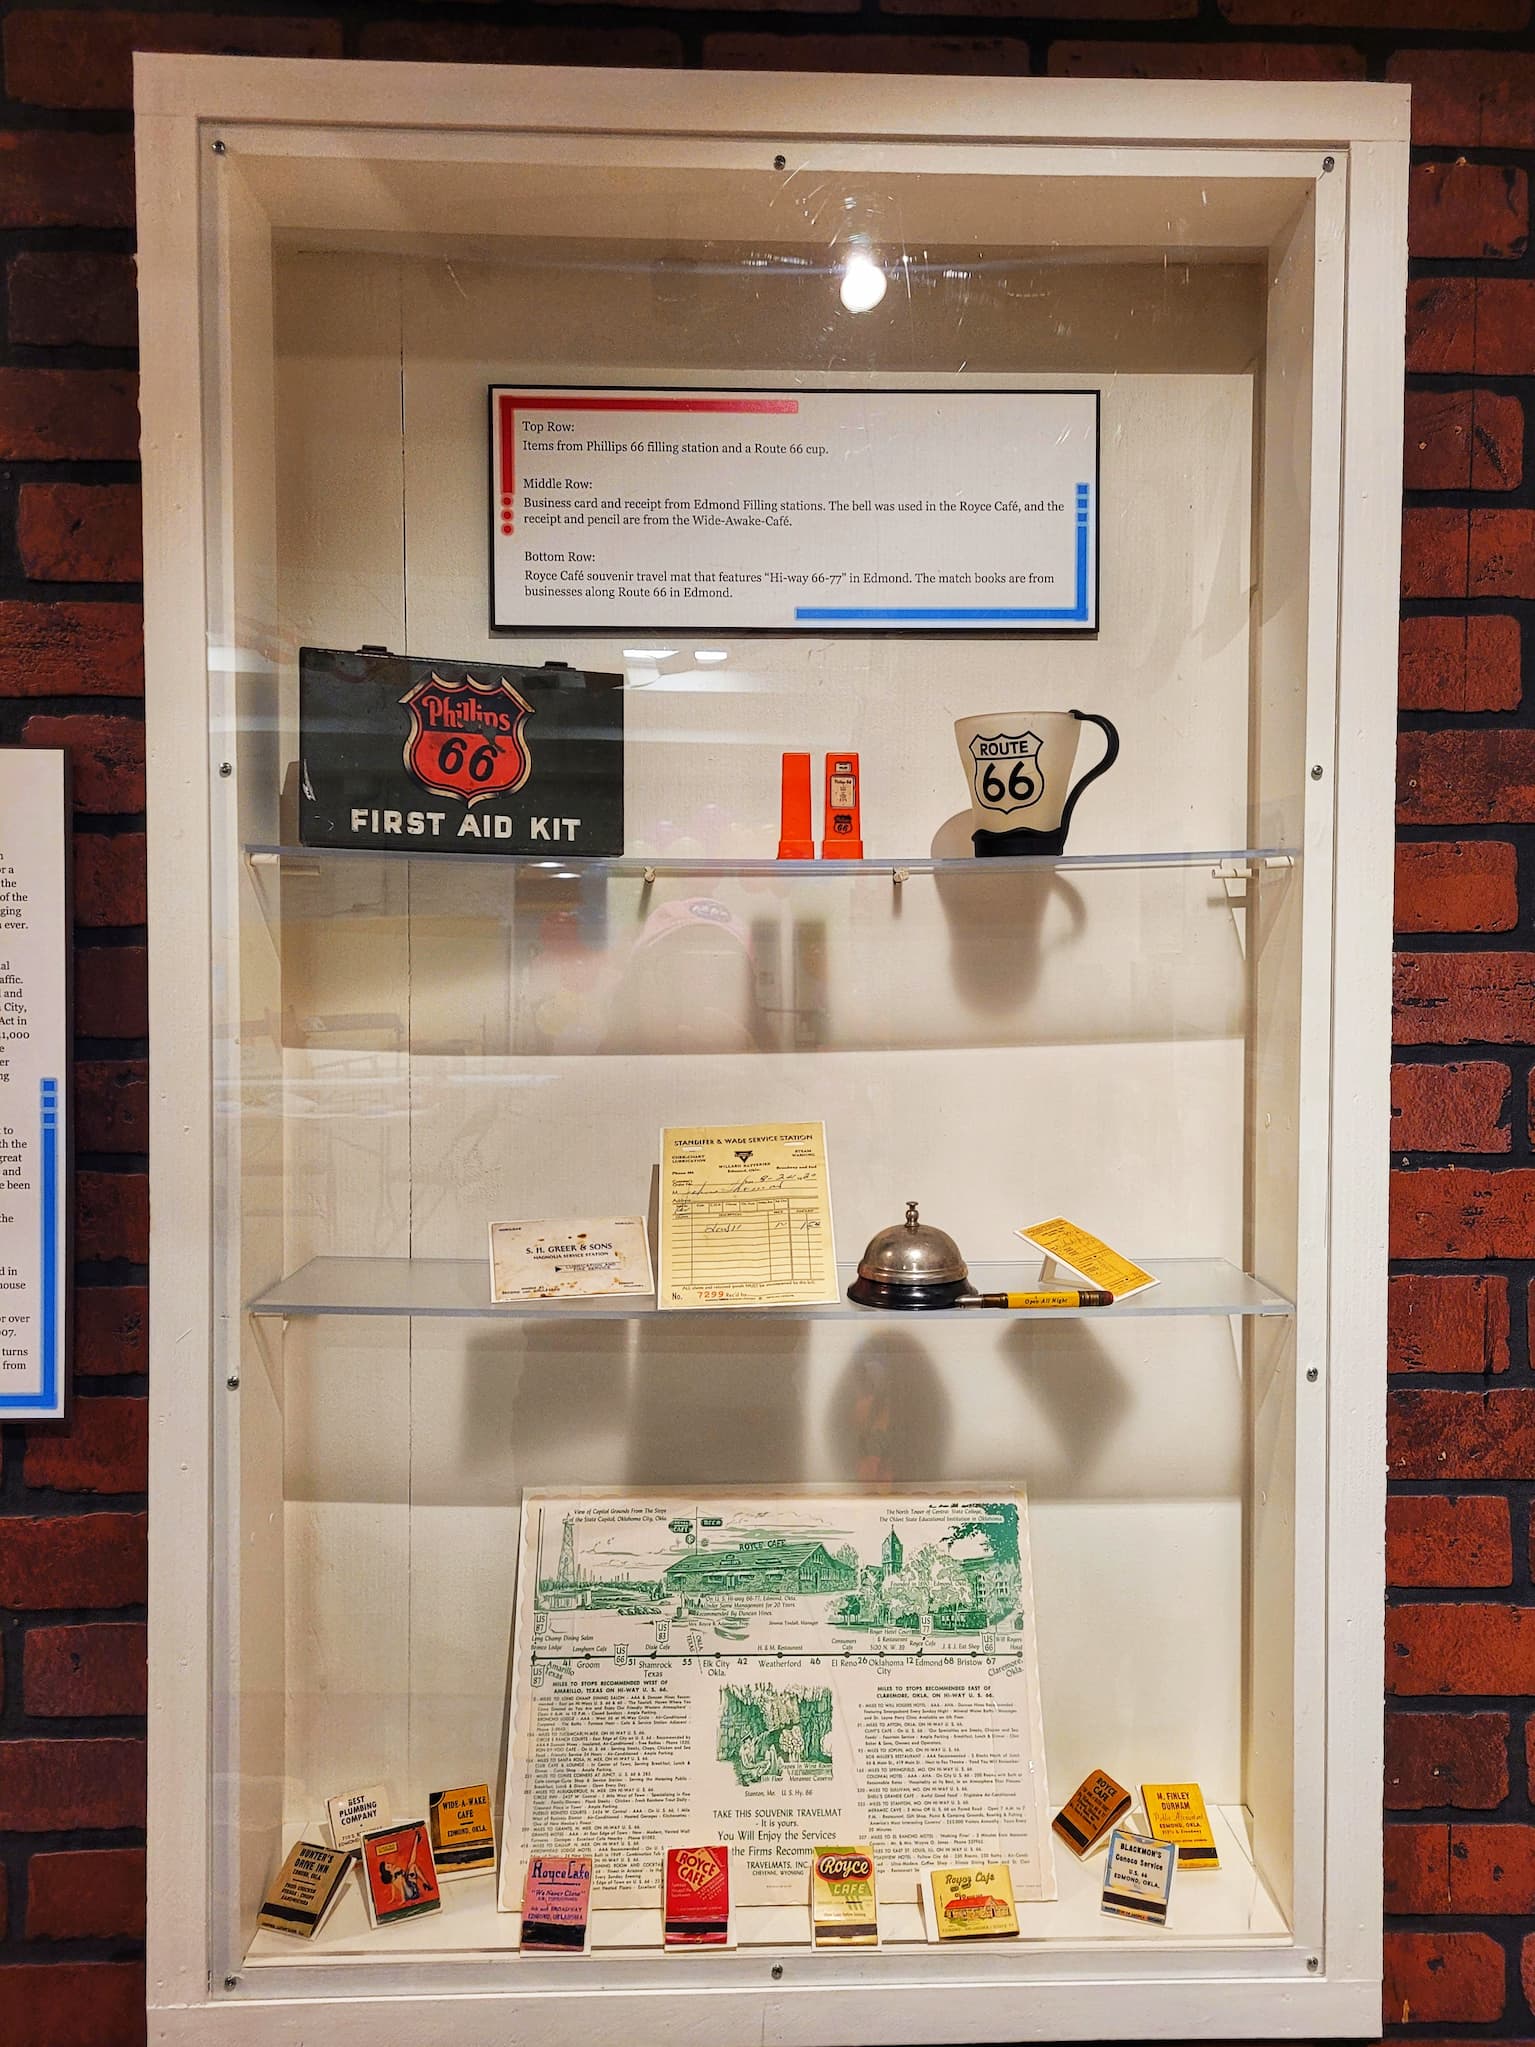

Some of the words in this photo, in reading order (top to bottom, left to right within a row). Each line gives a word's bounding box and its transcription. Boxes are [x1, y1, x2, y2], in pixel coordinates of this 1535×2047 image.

[523, 422, 543, 434] Top
[548, 422, 574, 432] Row:
[523, 441, 554, 450] Items
[557, 440, 583, 451] from
[587, 441, 627, 454] Phillips
[631, 442, 644, 452] 66
[648, 441, 680, 455] filling
[682, 442, 720, 453] station
[722, 443, 743, 453] and
[755, 443, 786, 453] Route
[790, 444, 803, 453] 66
[806, 447, 828, 456] cup.
[524, 478, 561, 488] Middle
[565, 479, 592, 489] Row:
[524, 497, 571, 508] Business
[574, 498, 598, 508] card
[601, 498, 621, 508] and
[625, 498, 661, 511] receipt
[665, 498, 690, 509] from
[694, 499, 740, 510] Edmond
[743, 499, 777, 513] Filling
[780, 500, 825, 511] stations.
[828, 500, 849, 511] The
[852, 500, 871, 511] bell
[898, 501, 923, 511] used
[926, 501, 936, 511] in
[939, 501, 956, 511] the
[960, 501, 991, 513] Royce
[995, 500, 1021, 512] Café,
[1024, 501, 1044, 511] and
[1047, 500, 1064, 511] the
[524, 513, 561, 526] receipt
[564, 513, 584, 524] and
[587, 514, 620, 527] pencil
[623, 517, 640, 525] are
[643, 514, 669, 525] from
[673, 514, 689, 525] the
[692, 515, 792, 526] Wide-Awake-Café.
[525, 551, 564, 562] Bottom
[568, 552, 595, 562] Row:
[525, 570, 557, 582] Royce
[560, 570, 584, 581] Café
[587, 571, 634, 581] souvenir
[637, 571, 666, 581] travel
[671, 573, 691, 582] mat
[694, 571, 715, 582] that
[719, 572, 761, 582] features
[850, 573, 860, 583] in
[864, 573, 912, 583] Edmond.
[915, 572, 935, 583] The
[939, 572, 971, 583] match
[974, 572, 1006, 583] books
[1029, 573, 1054, 583] from
[525, 586, 582, 596] businesses
[585, 586, 615, 599] along
[619, 587, 650, 597] Route
[653, 587, 666, 597] 66
[670, 587, 680, 597] in
[684, 587, 732, 597] Edmond.
[421, 695, 511, 731] Phillips
[979, 740, 1029, 756] ROUTE
[439, 737, 498, 782] 66
[982, 761, 1035, 803] 66
[350, 808, 446, 836] FIRST
[457, 814, 513, 840] AID
[530, 817, 582, 842] KIT
[12, 892, 28, 901] the
[4, 988, 22, 998] and
[4, 1002, 27, 1013] City,
[11, 1139, 27, 1149] the
[748, 1135, 778, 1144] SERVICE
[780, 1133, 814, 1143] STATION
[2, 1166, 21, 1176] and
[7, 1180, 31, 1190] been
[548, 1244, 577, 1253] GREER
[580, 1244, 587, 1252] &
[589, 1242, 614, 1251] SONS
[697, 1290, 725, 1298] 7299
[1024, 1297, 1040, 1306] Open
[1052, 1296, 1068, 1304] Night
[2, 1348, 29, 1357] turns
[2, 1360, 26, 1370] from
[740, 1541, 762, 1551] ROYCE
[768, 1540, 785, 1548] CAFE
[577, 1661, 600, 1669] Groom
[639, 1661, 672, 1669] Shamrock
[703, 1660, 713, 1668] Elk
[714, 1660, 729, 1669] City
[758, 1659, 801, 1668] Weatherford
[869, 1659, 904, 1667] Oklahoma
[915, 1659, 943, 1667] Edmond
[877, 1667, 891, 1676] City
[442, 1797, 487, 1810] WIDE-A-WAKE
[1161, 1801, 1191, 1810] DURHAM
[339, 1801, 377, 1818] PLUMBING
[457, 1809, 474, 1819] CAFE
[713, 1810, 732, 1818] TAKE
[736, 1809, 752, 1817] THIS
[755, 1808, 793, 1817] SOUVENIR
[797, 1809, 841, 1817] TRAVELMAT
[341, 1809, 377, 1826] COMPANY
[778, 1820, 799, 1829] yours.
[447, 1828, 470, 1838] EDMOND,
[472, 1825, 488, 1834] OKLA.
[718, 1831, 734, 1841] You
[738, 1831, 755, 1840] Will
[758, 1831, 783, 1842] Enjoy
[785, 1831, 799, 1840] the
[802, 1831, 836, 1840] Services
[732, 1847, 745, 1856] the
[748, 1846, 773, 1856] Firms
[1120, 1843, 1163, 1859] BLACKMON'S
[294, 1858, 315, 1871] DRIVE
[315, 1862, 330, 1873] INN
[679, 1852, 716, 1876] ROYCE
[747, 1861, 793, 1870] TRAVELMATS,
[818, 1856, 869, 1878] Royce
[1115, 1854, 1138, 1866] Conoco
[1140, 1859, 1164, 1871] Service
[531, 1862, 566, 1884] Royce
[679, 1866, 706, 1887] CAFE
[975, 1872, 995, 1882] Cafe
[833, 1883, 866, 1895] CAFE
